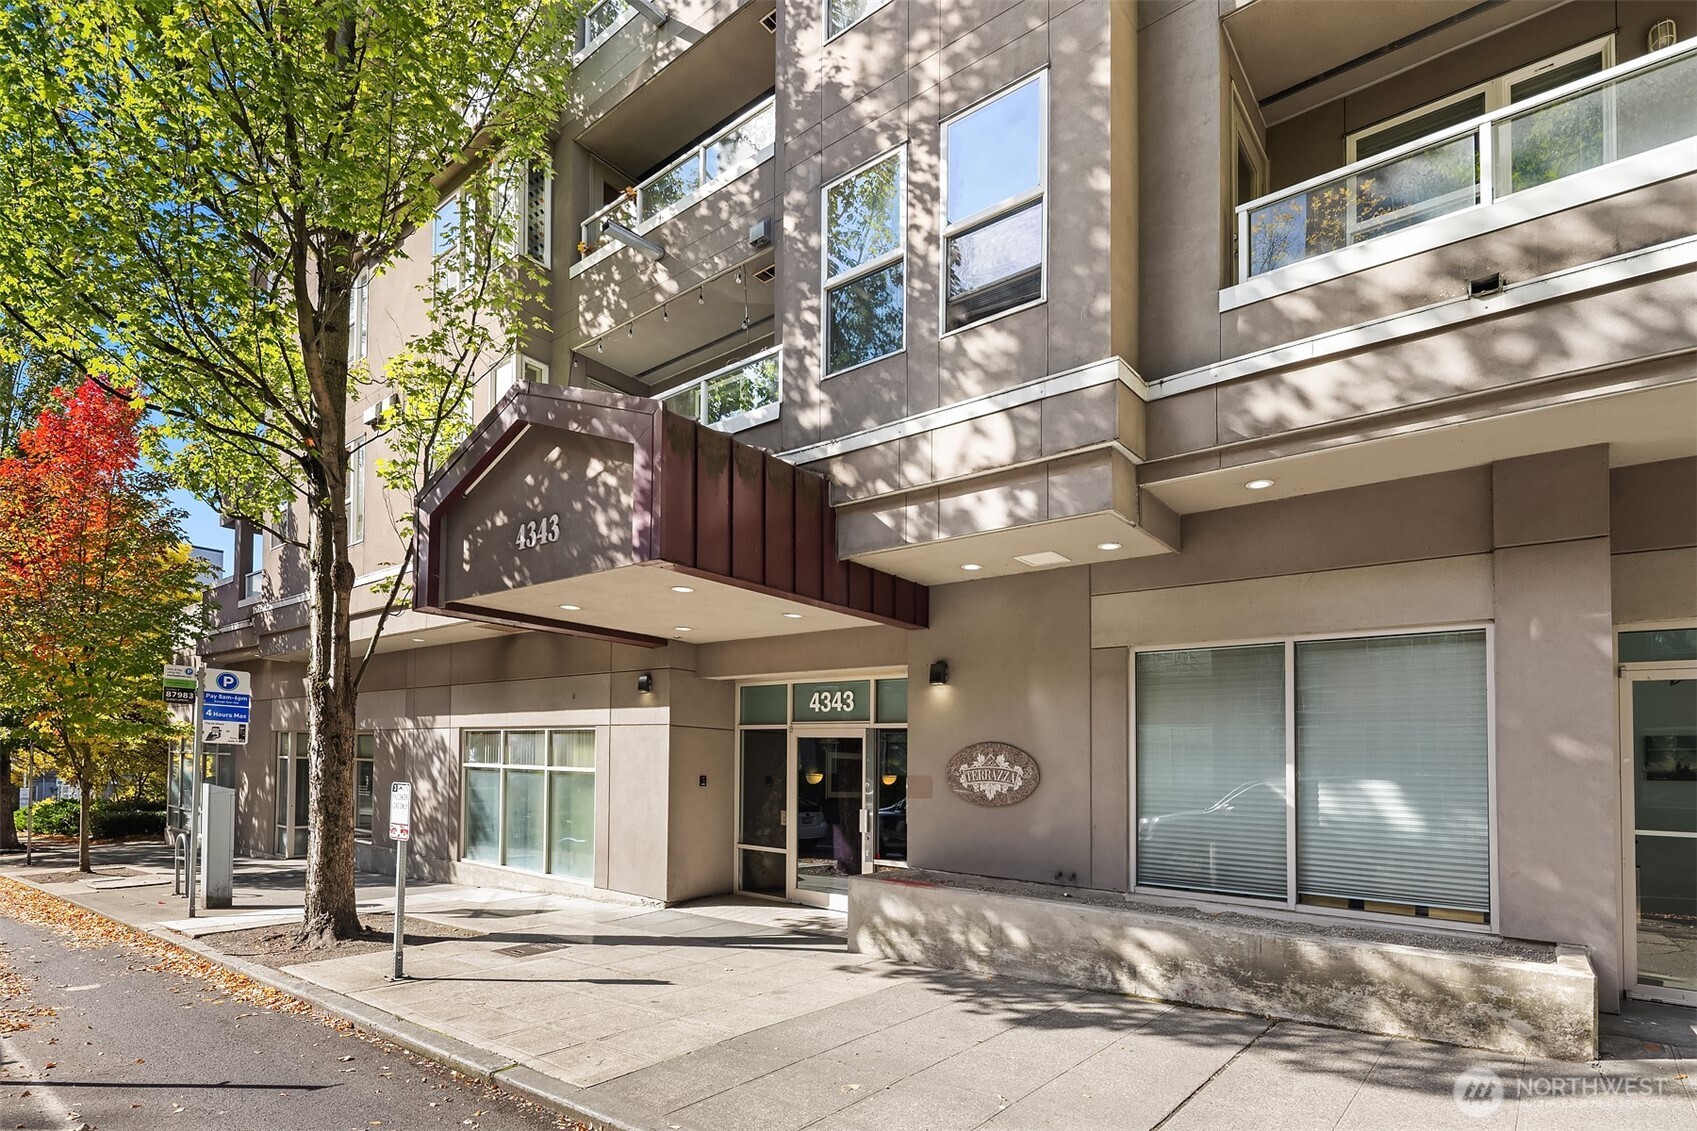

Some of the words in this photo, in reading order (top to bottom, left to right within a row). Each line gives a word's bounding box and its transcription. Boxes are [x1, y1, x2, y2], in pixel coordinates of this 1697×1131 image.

[515, 514, 560, 551] 4343
[223, 676, 235, 687] P
[165, 691, 194, 700] 87983
[809, 690, 855, 712] 4343
[205, 709, 212, 717] 4
[966, 767, 1016, 784] TERRAZZA
